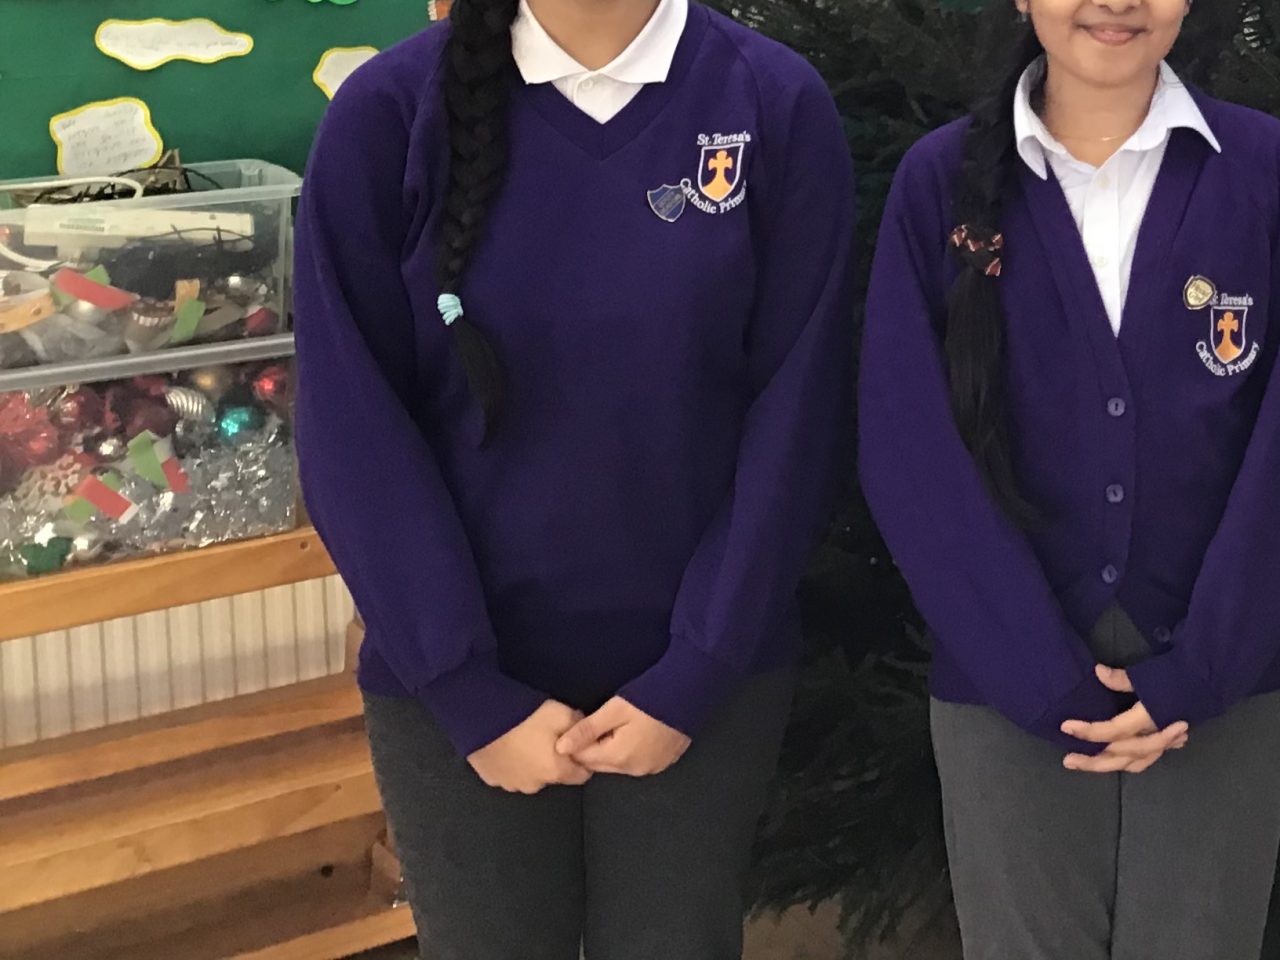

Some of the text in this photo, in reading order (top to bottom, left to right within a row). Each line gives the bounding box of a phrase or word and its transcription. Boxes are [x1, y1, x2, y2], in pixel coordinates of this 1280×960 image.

[712, 130, 751, 145] Teresa's
[680, 178, 717, 214] Catholic
[1220, 293, 1254, 306] Teresa's
[1195, 341, 1260, 377] Catholic Primary
